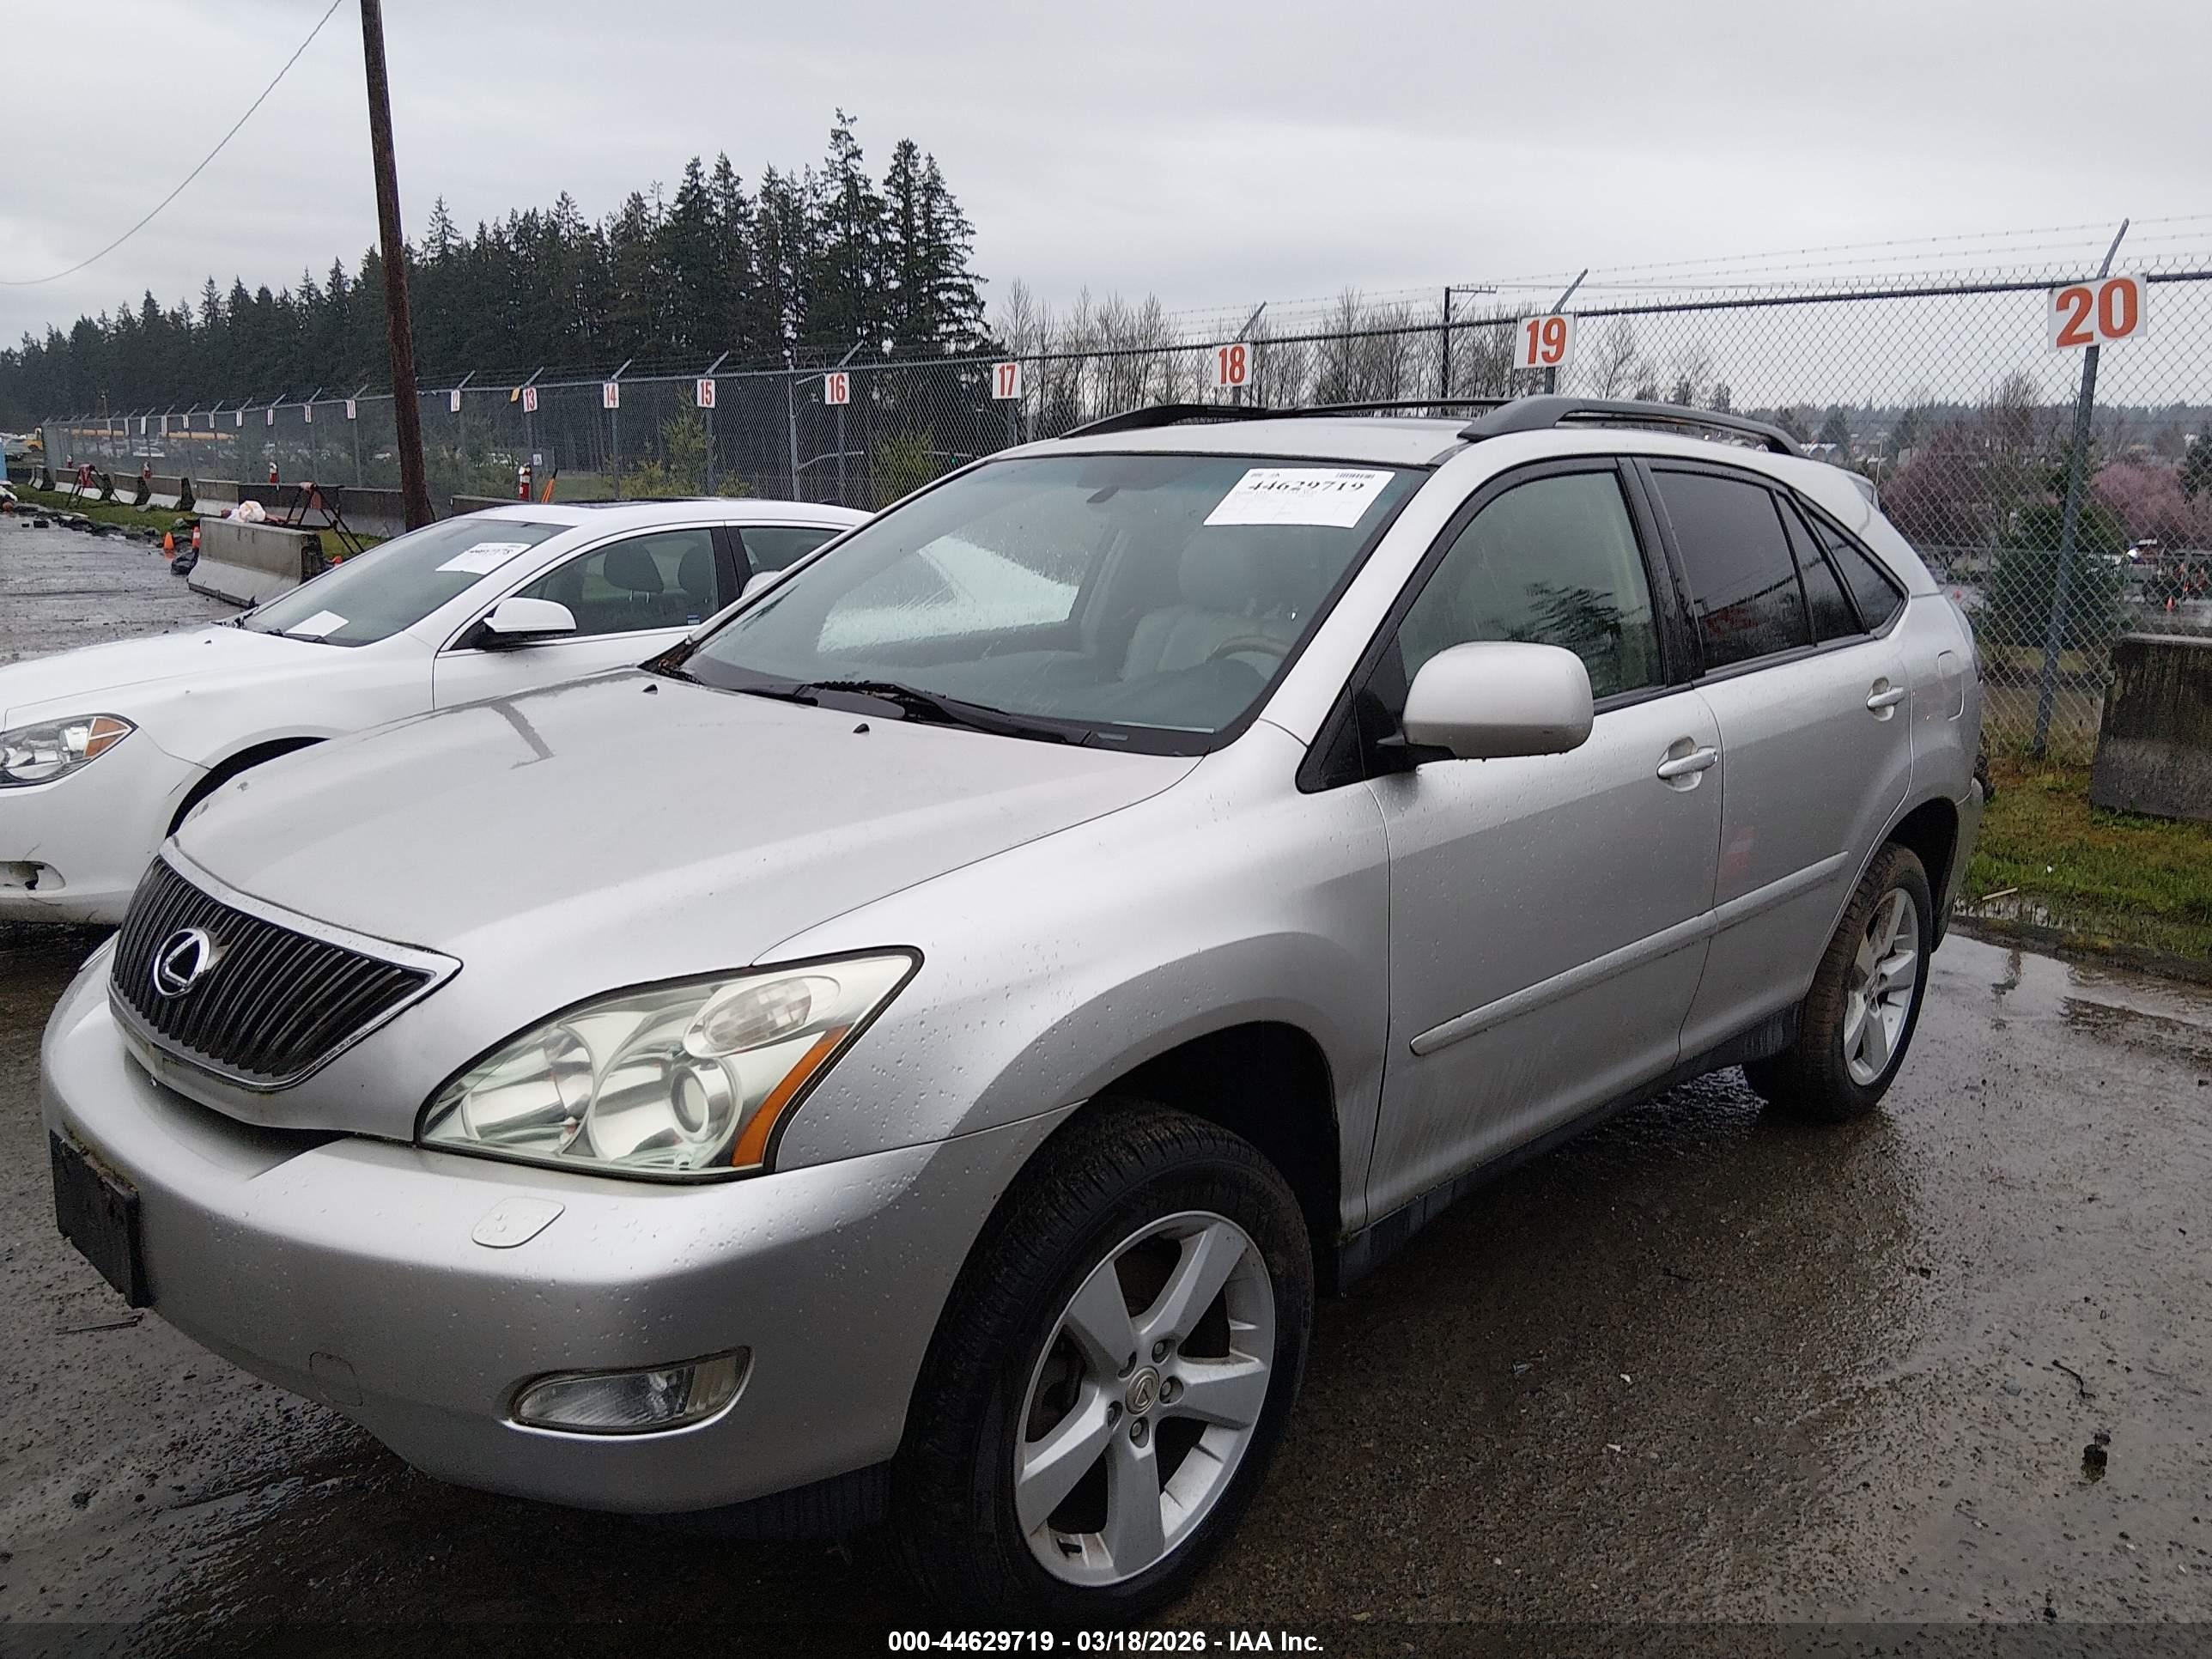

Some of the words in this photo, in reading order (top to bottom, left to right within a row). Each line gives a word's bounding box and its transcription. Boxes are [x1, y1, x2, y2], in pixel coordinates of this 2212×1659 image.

[2056, 278, 2138, 347] 20
[1526, 316, 1567, 365] 19
[1218, 346, 1246, 384] 18
[700, 380, 713, 406] 15
[829, 374, 847, 402] 16
[998, 364, 1016, 396] 17
[525, 390, 535, 410] 13
[605, 386, 617, 406] 14
[1248, 481, 1365, 490] 44629719
